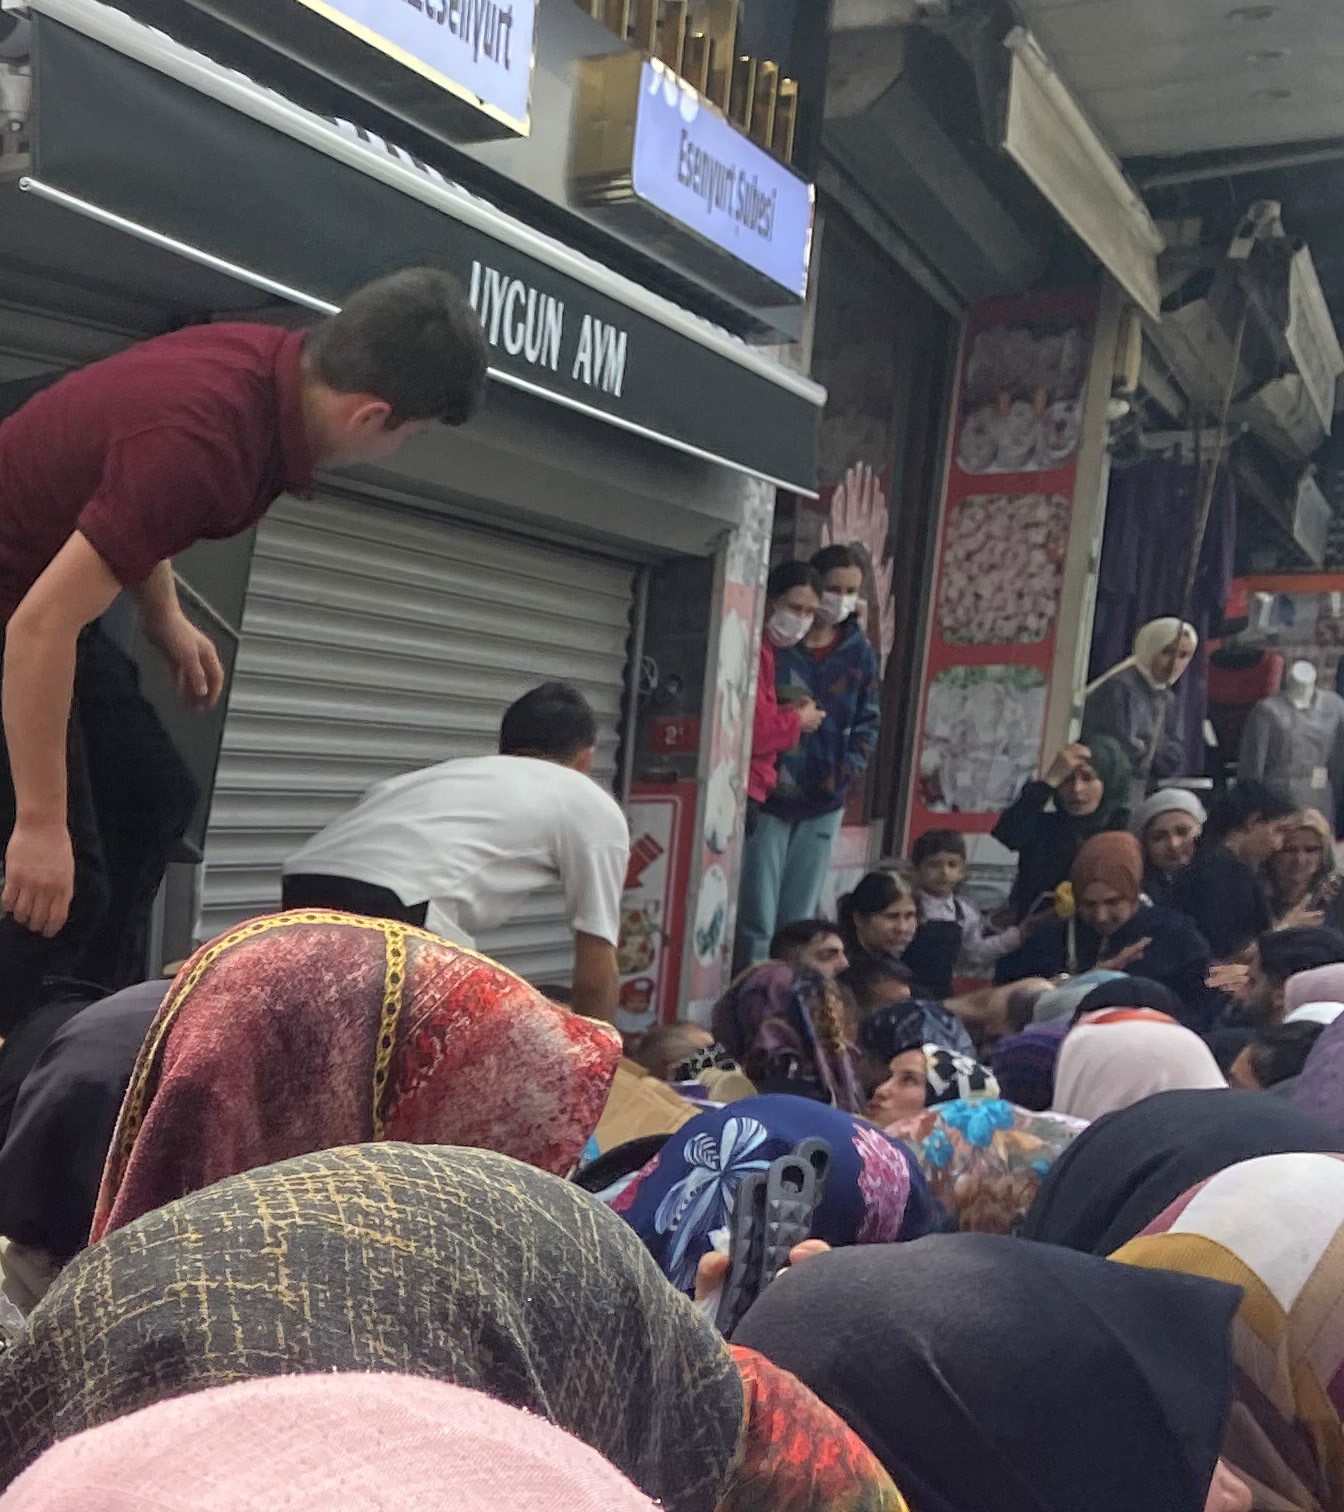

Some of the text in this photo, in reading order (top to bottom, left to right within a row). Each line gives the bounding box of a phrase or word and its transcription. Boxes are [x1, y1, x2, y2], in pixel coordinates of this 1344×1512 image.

[677, 127, 736, 217] Esenyurt
[469, 260, 629, 398] UYGUN AVM
